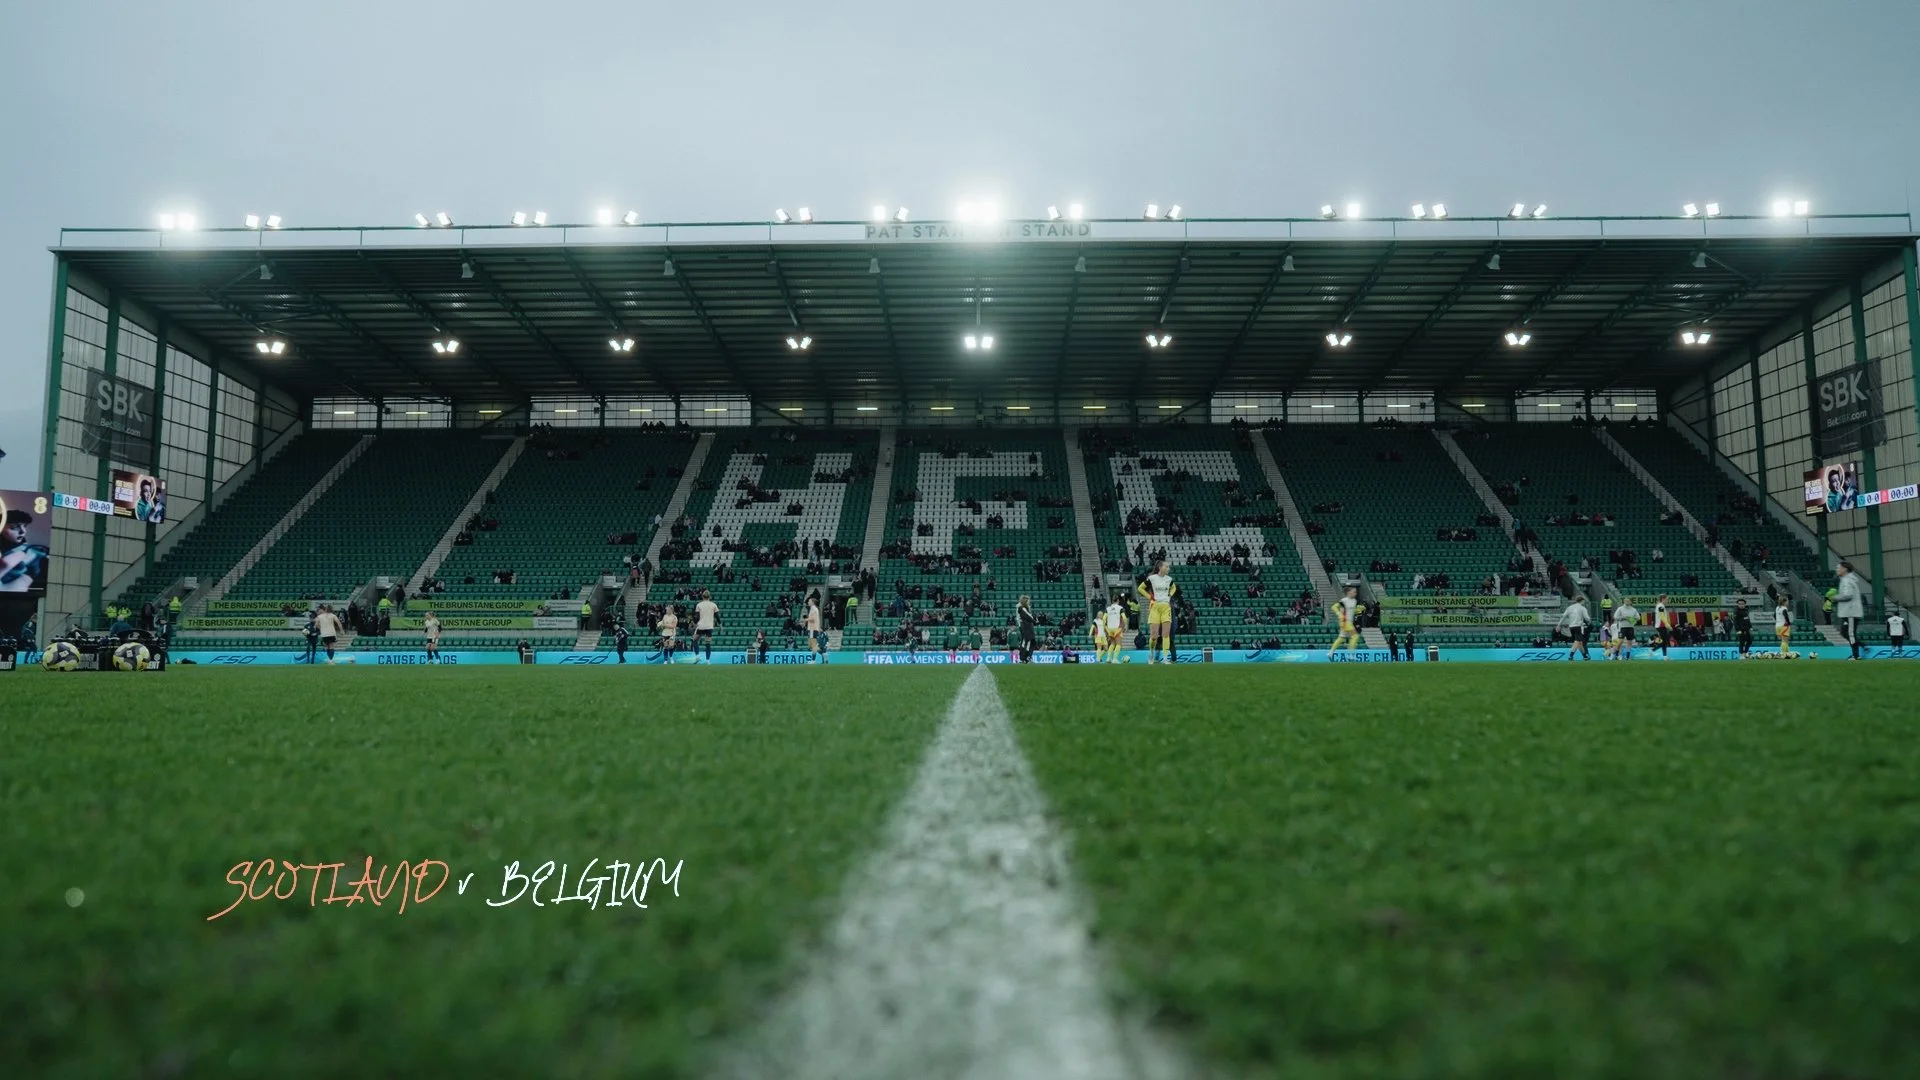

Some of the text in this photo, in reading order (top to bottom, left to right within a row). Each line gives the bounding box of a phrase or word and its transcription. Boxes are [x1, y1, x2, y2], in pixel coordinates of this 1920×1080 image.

[866, 225, 903, 238] PAT
[1022, 223, 1089, 236] STAND
[1820, 370, 1868, 412] SBK
[97, 379, 143, 422] SBK
[1891, 486, 1914, 500] 00:00
[64, 496, 78, 507] 0-0
[89, 500, 110, 512] 00:00
[1449, 615, 1501, 624] BRUNSTANE
[378, 655, 457, 664] CAUSE COS
[774, 655, 812, 664] CHAOS
[868, 655, 893, 664] FIFA
[896, 655, 943, 664] WOMEN'S
[985, 655, 1005, 663] CUP
[1039, 655, 1058, 664] 2027
[1332, 653, 1370, 662] CASE
[1690, 651, 1728, 660] CAUSE
